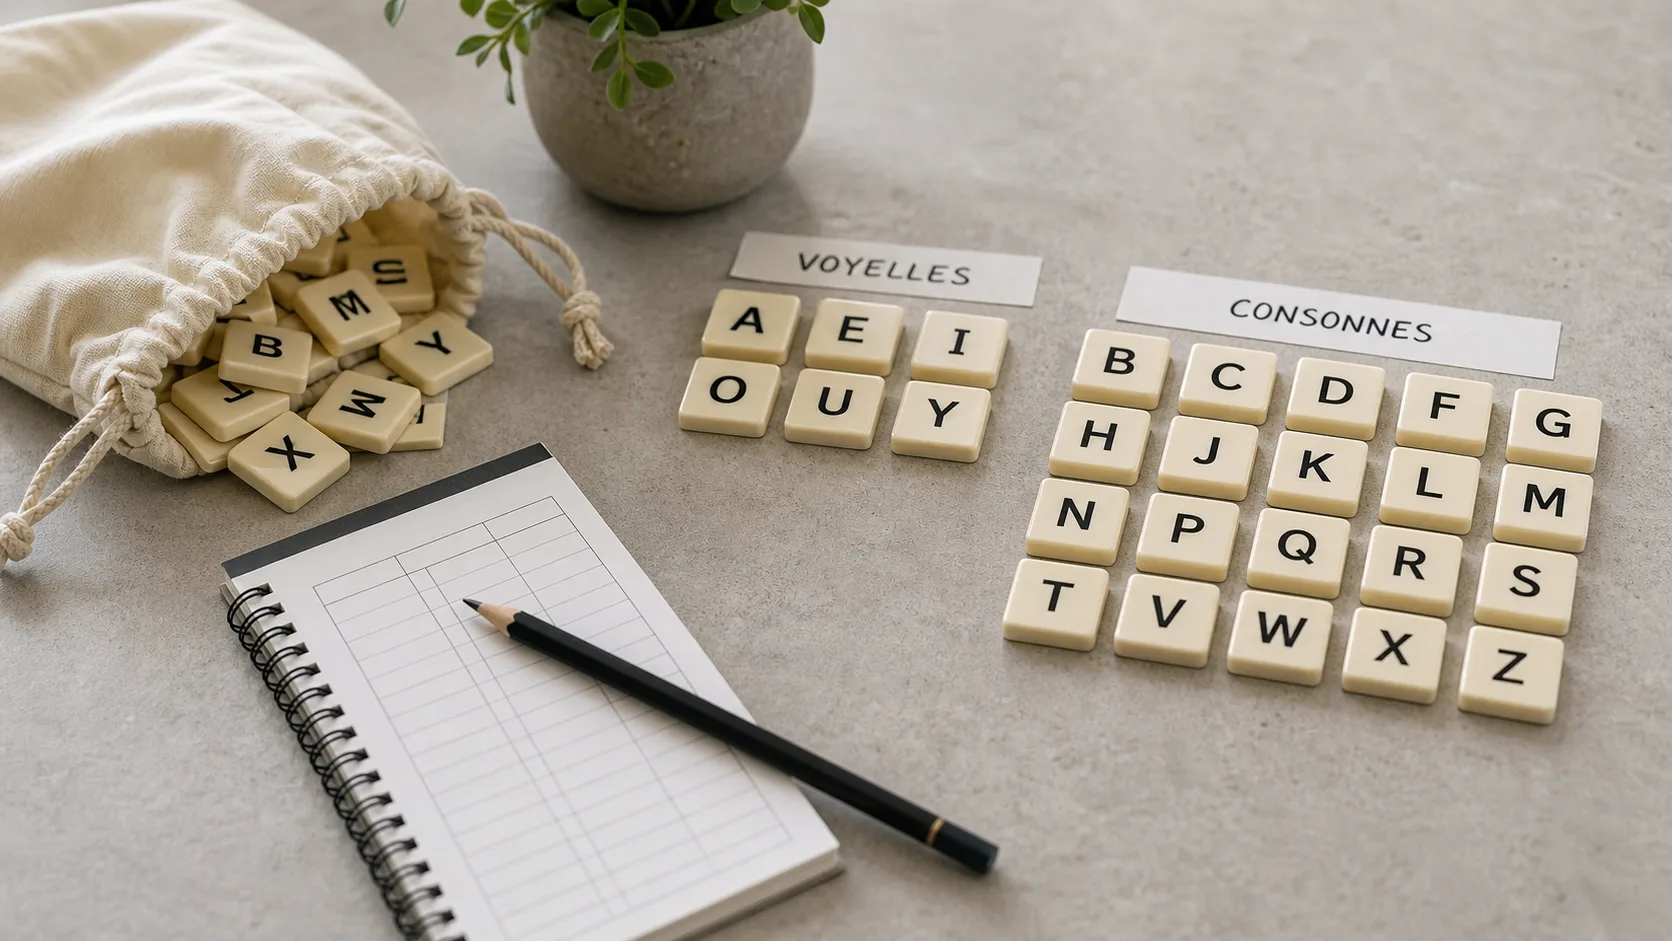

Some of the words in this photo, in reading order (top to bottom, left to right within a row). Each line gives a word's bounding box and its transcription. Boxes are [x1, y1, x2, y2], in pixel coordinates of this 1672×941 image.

[798, 252, 970, 285] VOYELLES
[251, 333, 283, 358] B
[415, 330, 452, 355] Y
[730, 307, 764, 334] A
[837, 315, 869, 344] E
[948, 328, 971, 356] I
[1230, 299, 1432, 343] CONSONNES
[709, 375, 747, 404] O
[817, 386, 854, 416] U
[927, 398, 960, 428] Y
[1103, 346, 1136, 375] B
[1211, 362, 1246, 391] C
[1318, 375, 1354, 405] D
[1430, 391, 1461, 420] F
[1535, 408, 1571, 438] G
[264, 434, 316, 472] X
[1080, 420, 1118, 452] H
[1192, 436, 1221, 465] J
[1298, 449, 1335, 483] K
[1416, 466, 1443, 499] L
[1523, 483, 1566, 518] M
[1056, 497, 1096, 531] N
[1170, 513, 1205, 544] P
[1277, 529, 1317, 565] Q
[1393, 545, 1426, 581] R
[1509, 564, 1541, 598] S
[1042, 579, 1075, 612] T
[1152, 594, 1187, 628] V
[1258, 610, 1308, 648] W
[1374, 629, 1413, 666] X
[1492, 648, 1527, 685] Z
